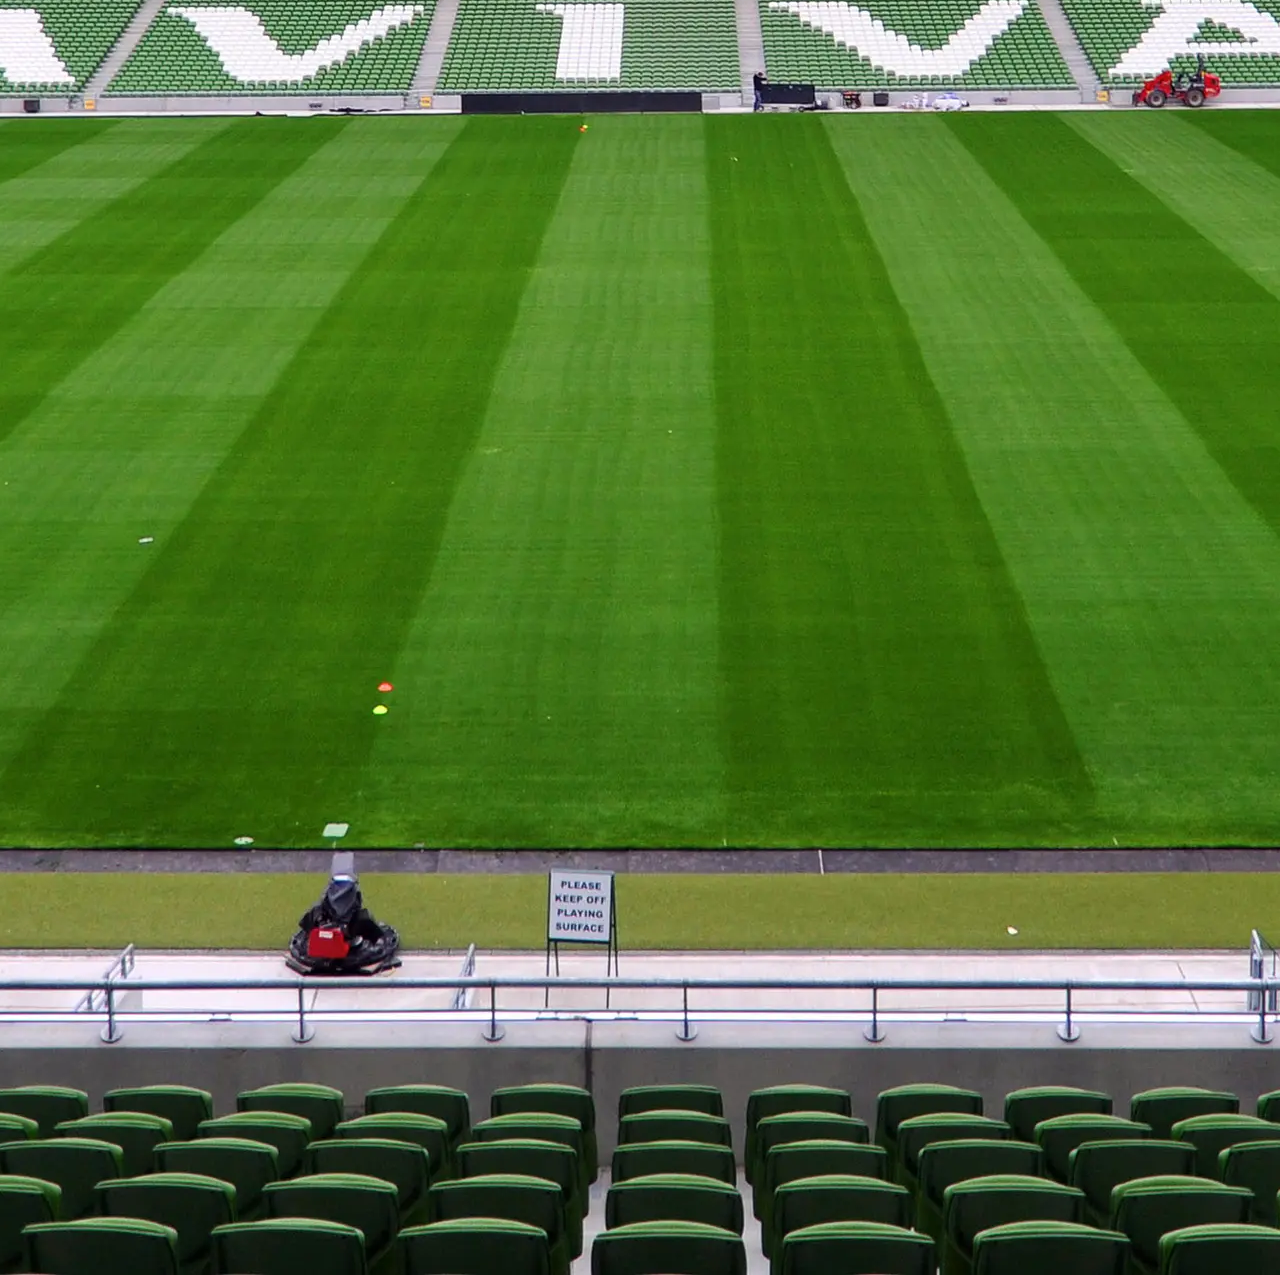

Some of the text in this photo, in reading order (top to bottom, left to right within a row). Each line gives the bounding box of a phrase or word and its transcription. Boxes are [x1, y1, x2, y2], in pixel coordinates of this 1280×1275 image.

[561, 881, 601, 890] PLEASE
[555, 894, 606, 905] KEEP OFF
[557, 909, 603, 918] PLAYING
[556, 923, 604, 933] SURFACE
